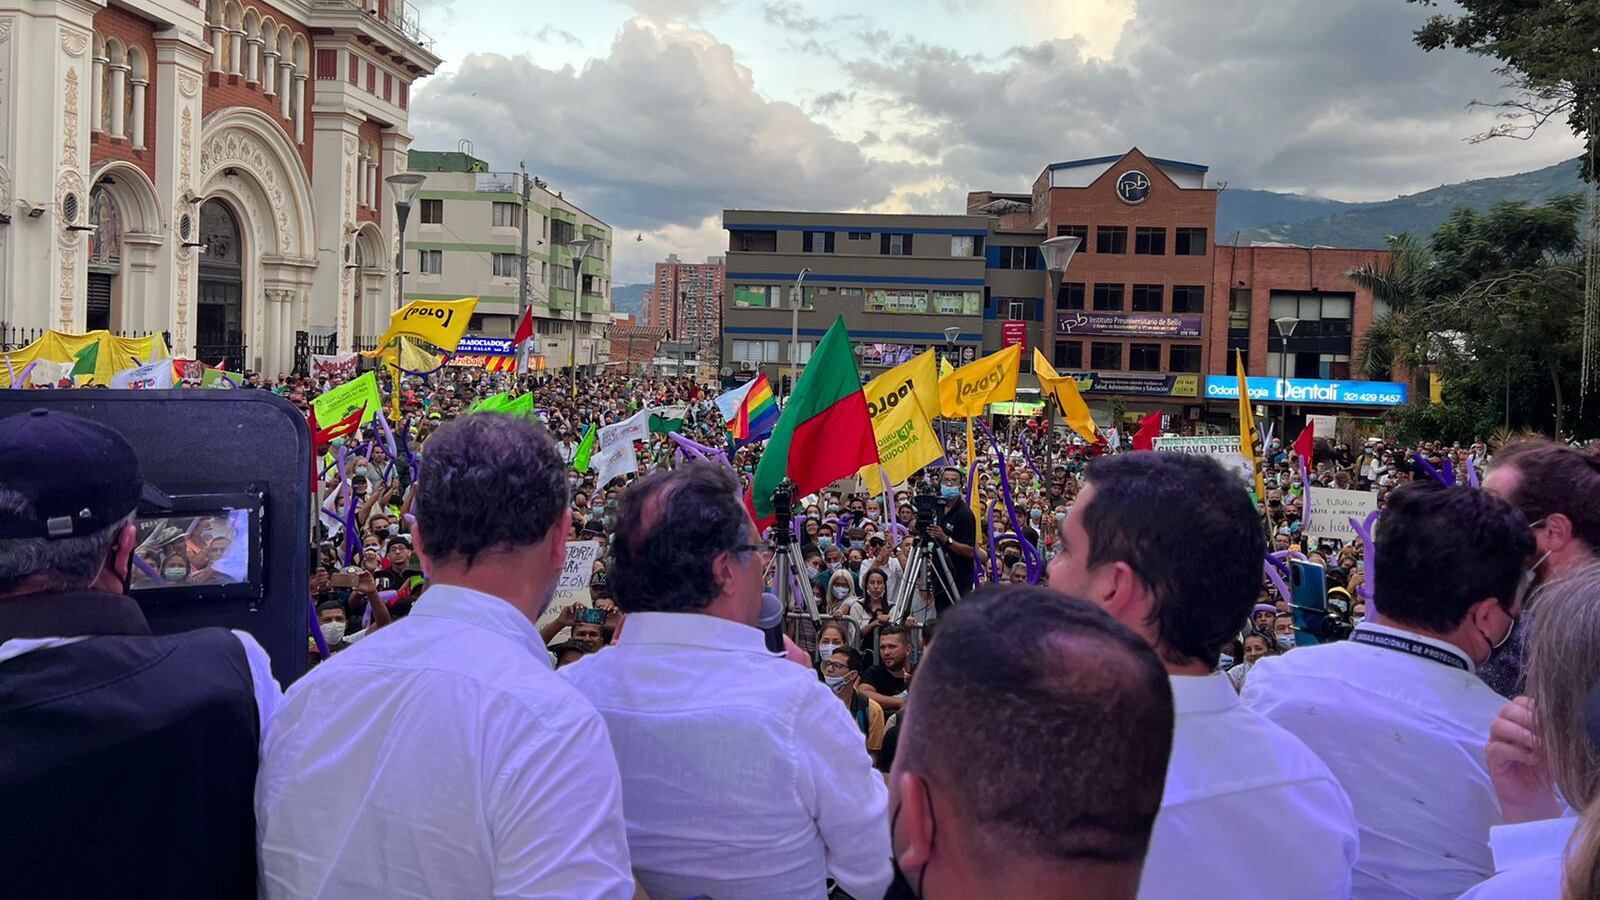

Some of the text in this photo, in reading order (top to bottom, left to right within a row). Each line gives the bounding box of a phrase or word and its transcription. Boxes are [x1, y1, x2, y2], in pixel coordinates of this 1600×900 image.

[1120, 175, 1148, 197] ipb
[1060, 313, 1088, 333] ipb
[1089, 316, 1113, 324] Instituto
[1167, 318, 1182, 326] Bello
[467, 339, 504, 347] ASOCIADOS
[1146, 385, 1168, 393] Educación
[1276, 379, 1338, 401] Dentali
[1344, 392, 1358, 401] 321
[1360, 393, 1376, 402] 429
[1379, 394, 1401, 403] 5457
[1158, 445, 1207, 454] GUSTAVO
[559, 575, 587, 588] ZÓN
[1375, 635, 1410, 651] NACIONAL
[1411, 644, 1422, 654] DE
